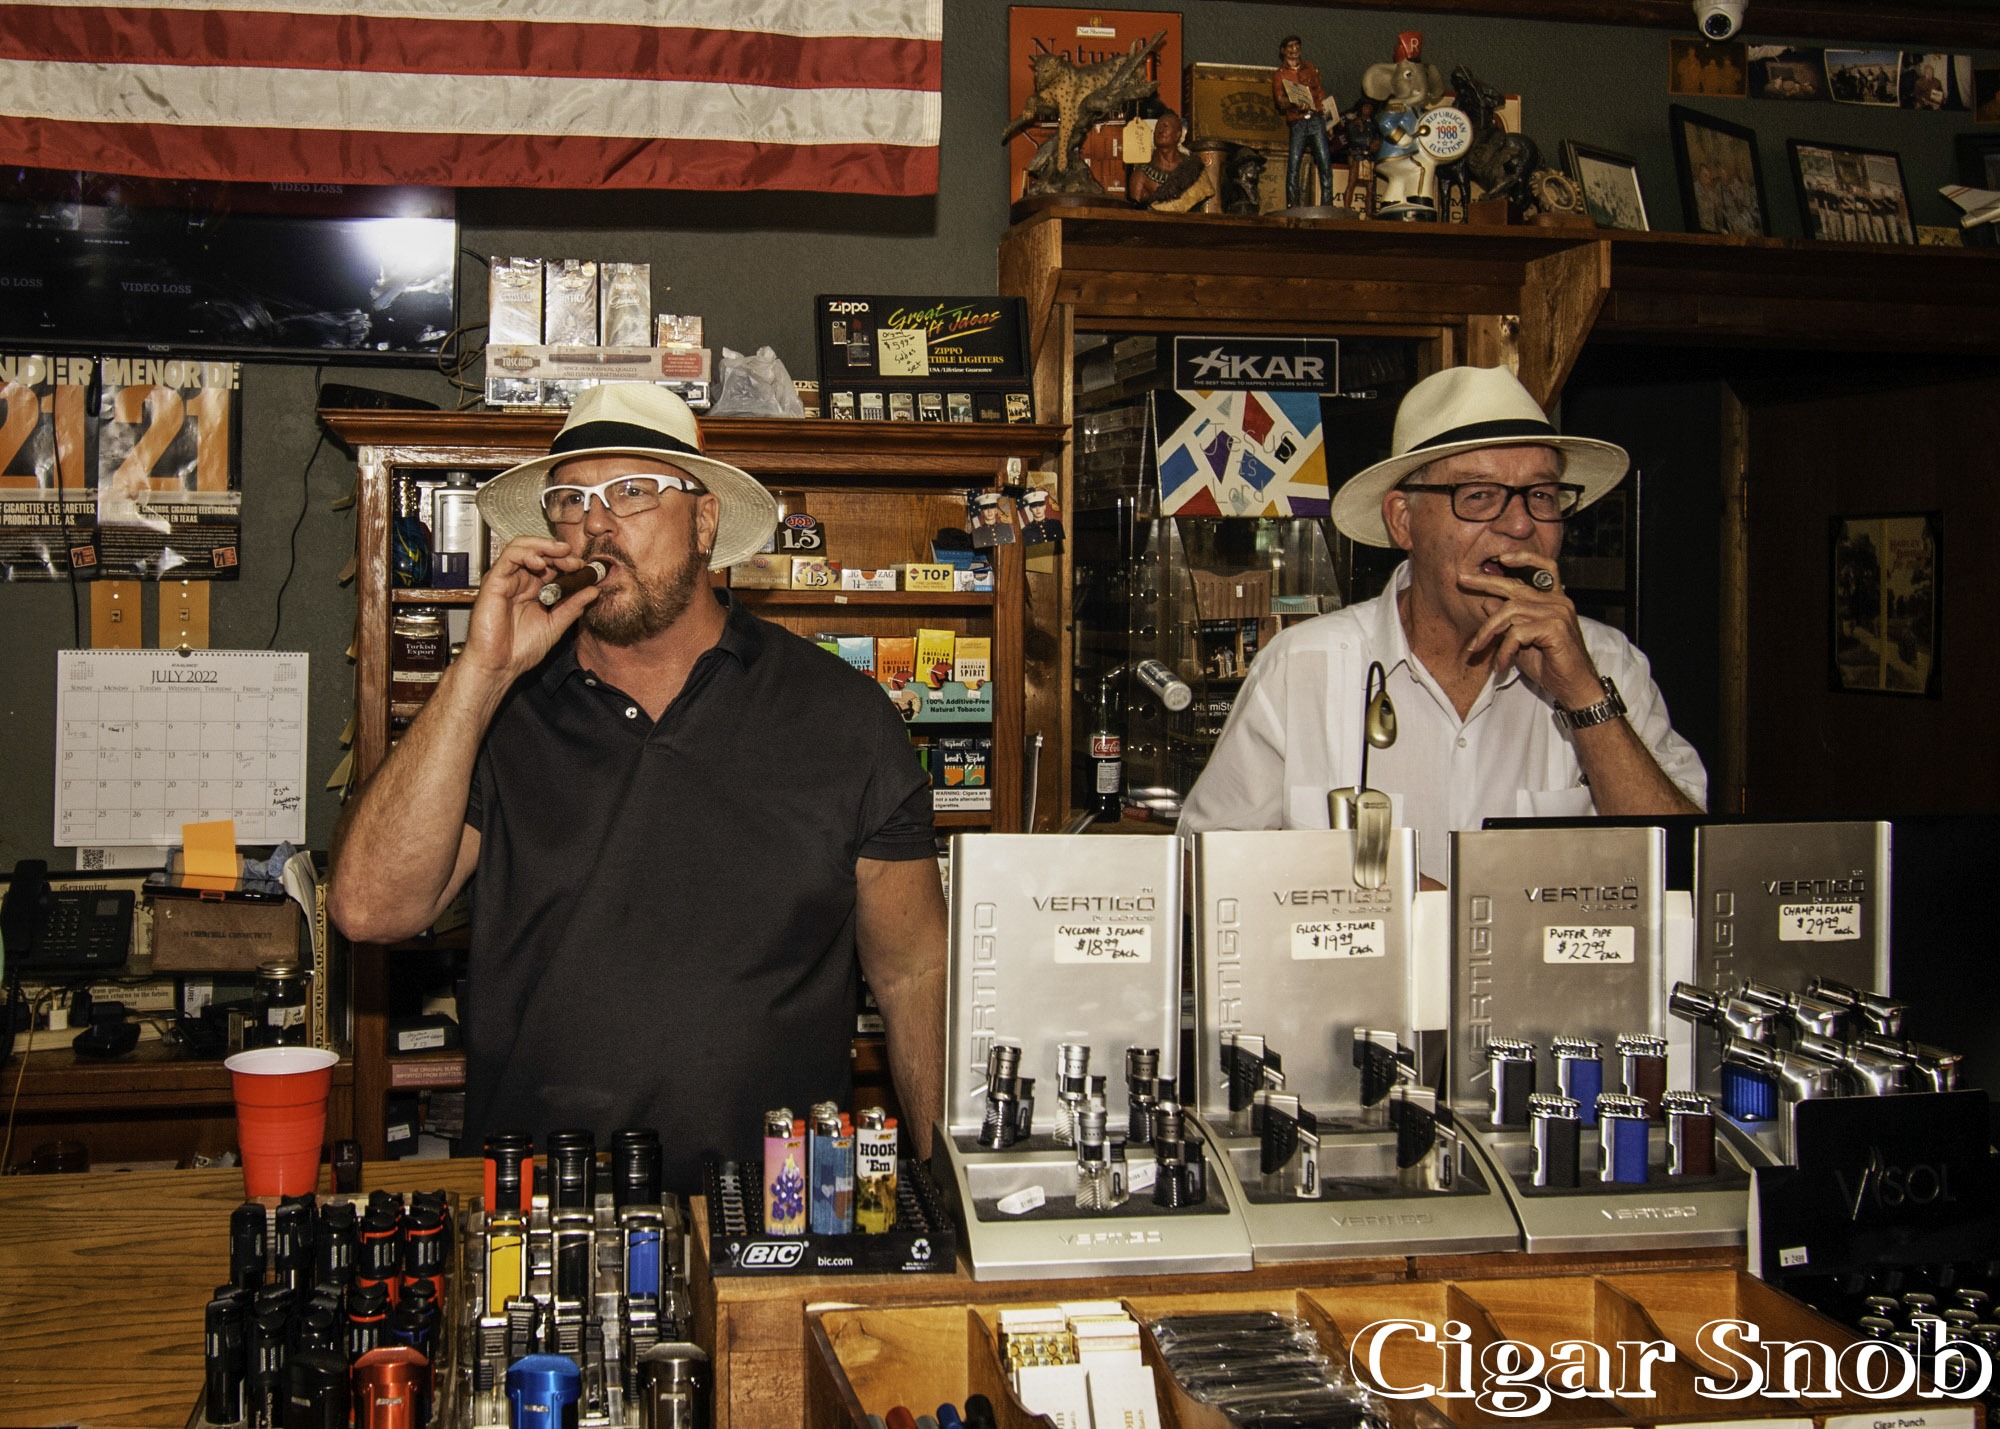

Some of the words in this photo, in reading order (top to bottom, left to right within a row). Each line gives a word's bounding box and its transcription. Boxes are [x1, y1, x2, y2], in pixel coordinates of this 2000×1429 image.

[1425, 110, 1467, 134] REPUBLICAN
[1435, 126, 1458, 140] 1988
[1430, 139, 1465, 155] ELECTION
[270, 181, 308, 194] VIDEO
[311, 183, 344, 195] LOSS
[13, 277, 43, 287] LOSS
[121, 281, 160, 293] VIDEO
[162, 283, 192, 294] LOSS
[934, 347, 963, 355] ZIPPO
[502, 358, 533, 368] TOSCANO
[958, 356, 1004, 364] LIGHTERS
[102, 358, 200, 389] MENOR
[207, 362, 240, 389] DE
[113, 384, 230, 492] 21
[3, 514, 40, 526] PRODUCTS
[42, 515, 49, 526] IN
[789, 516, 812, 526] JOB
[782, 529, 821, 549] 1.5
[922, 569, 950, 581] TOP
[152, 671, 184, 684] JULY
[187, 671, 217, 683] 2022
[1524, 885, 1639, 902] VERTIGO
[1762, 878, 1865, 896] VERTIGO
[1273, 889, 1392, 905] VERTIGO
[1032, 896, 1155, 912] VERTIGO
[1783, 905, 1815, 916] CHAMP
[1816, 905, 1823, 915] 4
[1825, 905, 1853, 915] FLAME
[1115, 927, 1144, 936] FLAME
[1296, 923, 1331, 934] GLOCK
[1550, 928, 1588, 938] PUFFER
[1592, 928, 1612, 938] PIPE
[860, 1143, 896, 1156] HOOK
[818, 1257, 853, 1266] bic.com
[1873, 1419, 1896, 1429] Cigar
[1898, 1417, 1926, 1428] Punch
